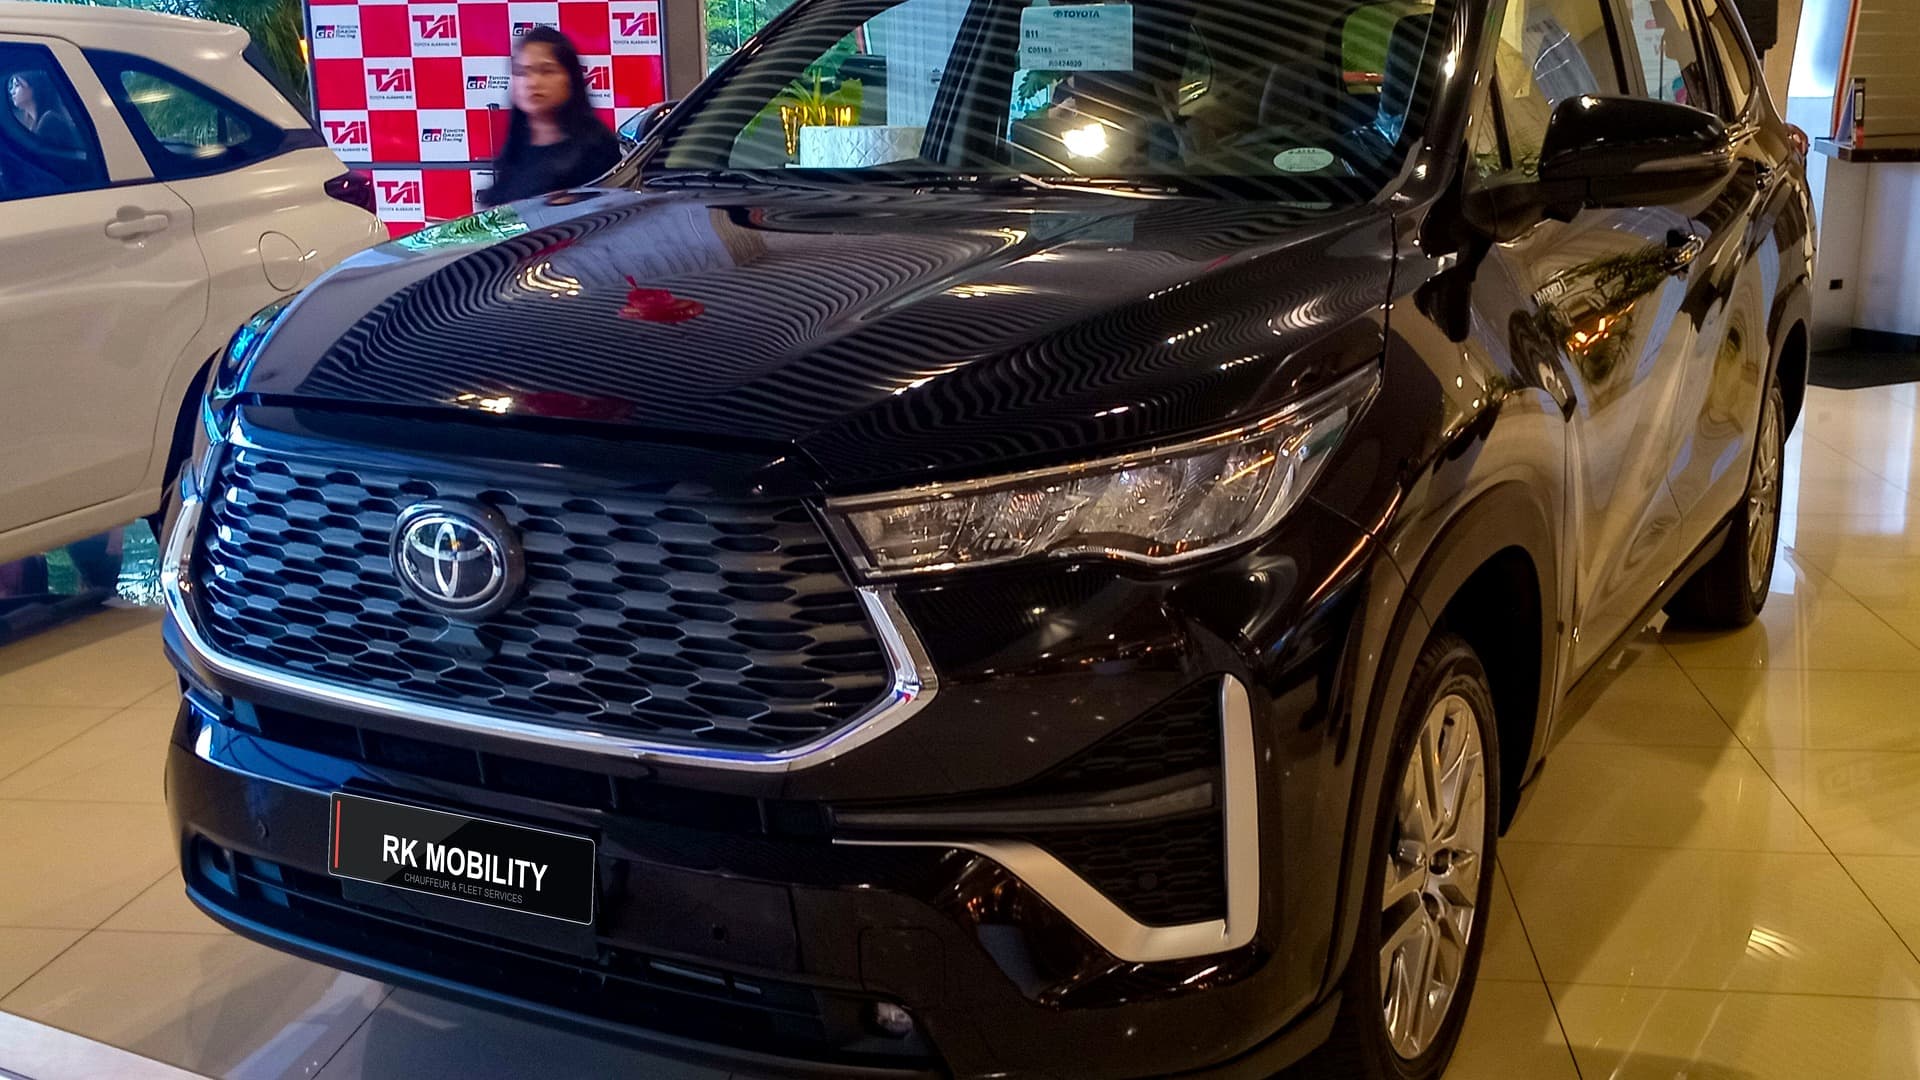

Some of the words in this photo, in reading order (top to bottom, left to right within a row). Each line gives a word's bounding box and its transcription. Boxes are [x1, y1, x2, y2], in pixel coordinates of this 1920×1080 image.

[612, 12, 657, 36] TAI
[1063, 10, 1100, 18] TOYOTA
[315, 26, 335, 38] GR
[412, 15, 456, 38] TAI
[368, 68, 412, 92] TAI
[466, 77, 488, 89] GR
[324, 121, 368, 144] TAI
[421, 129, 442, 142] GR
[377, 181, 420, 204] TAI
[382, 834, 418, 869] RK
[425, 842, 548, 891] MOBILITY
[404, 873, 450, 890] CHAUFFEUR
[451, 882, 457, 891] &
[458, 883, 482, 897] FLEET
[483, 888, 523, 904] SERVICES
